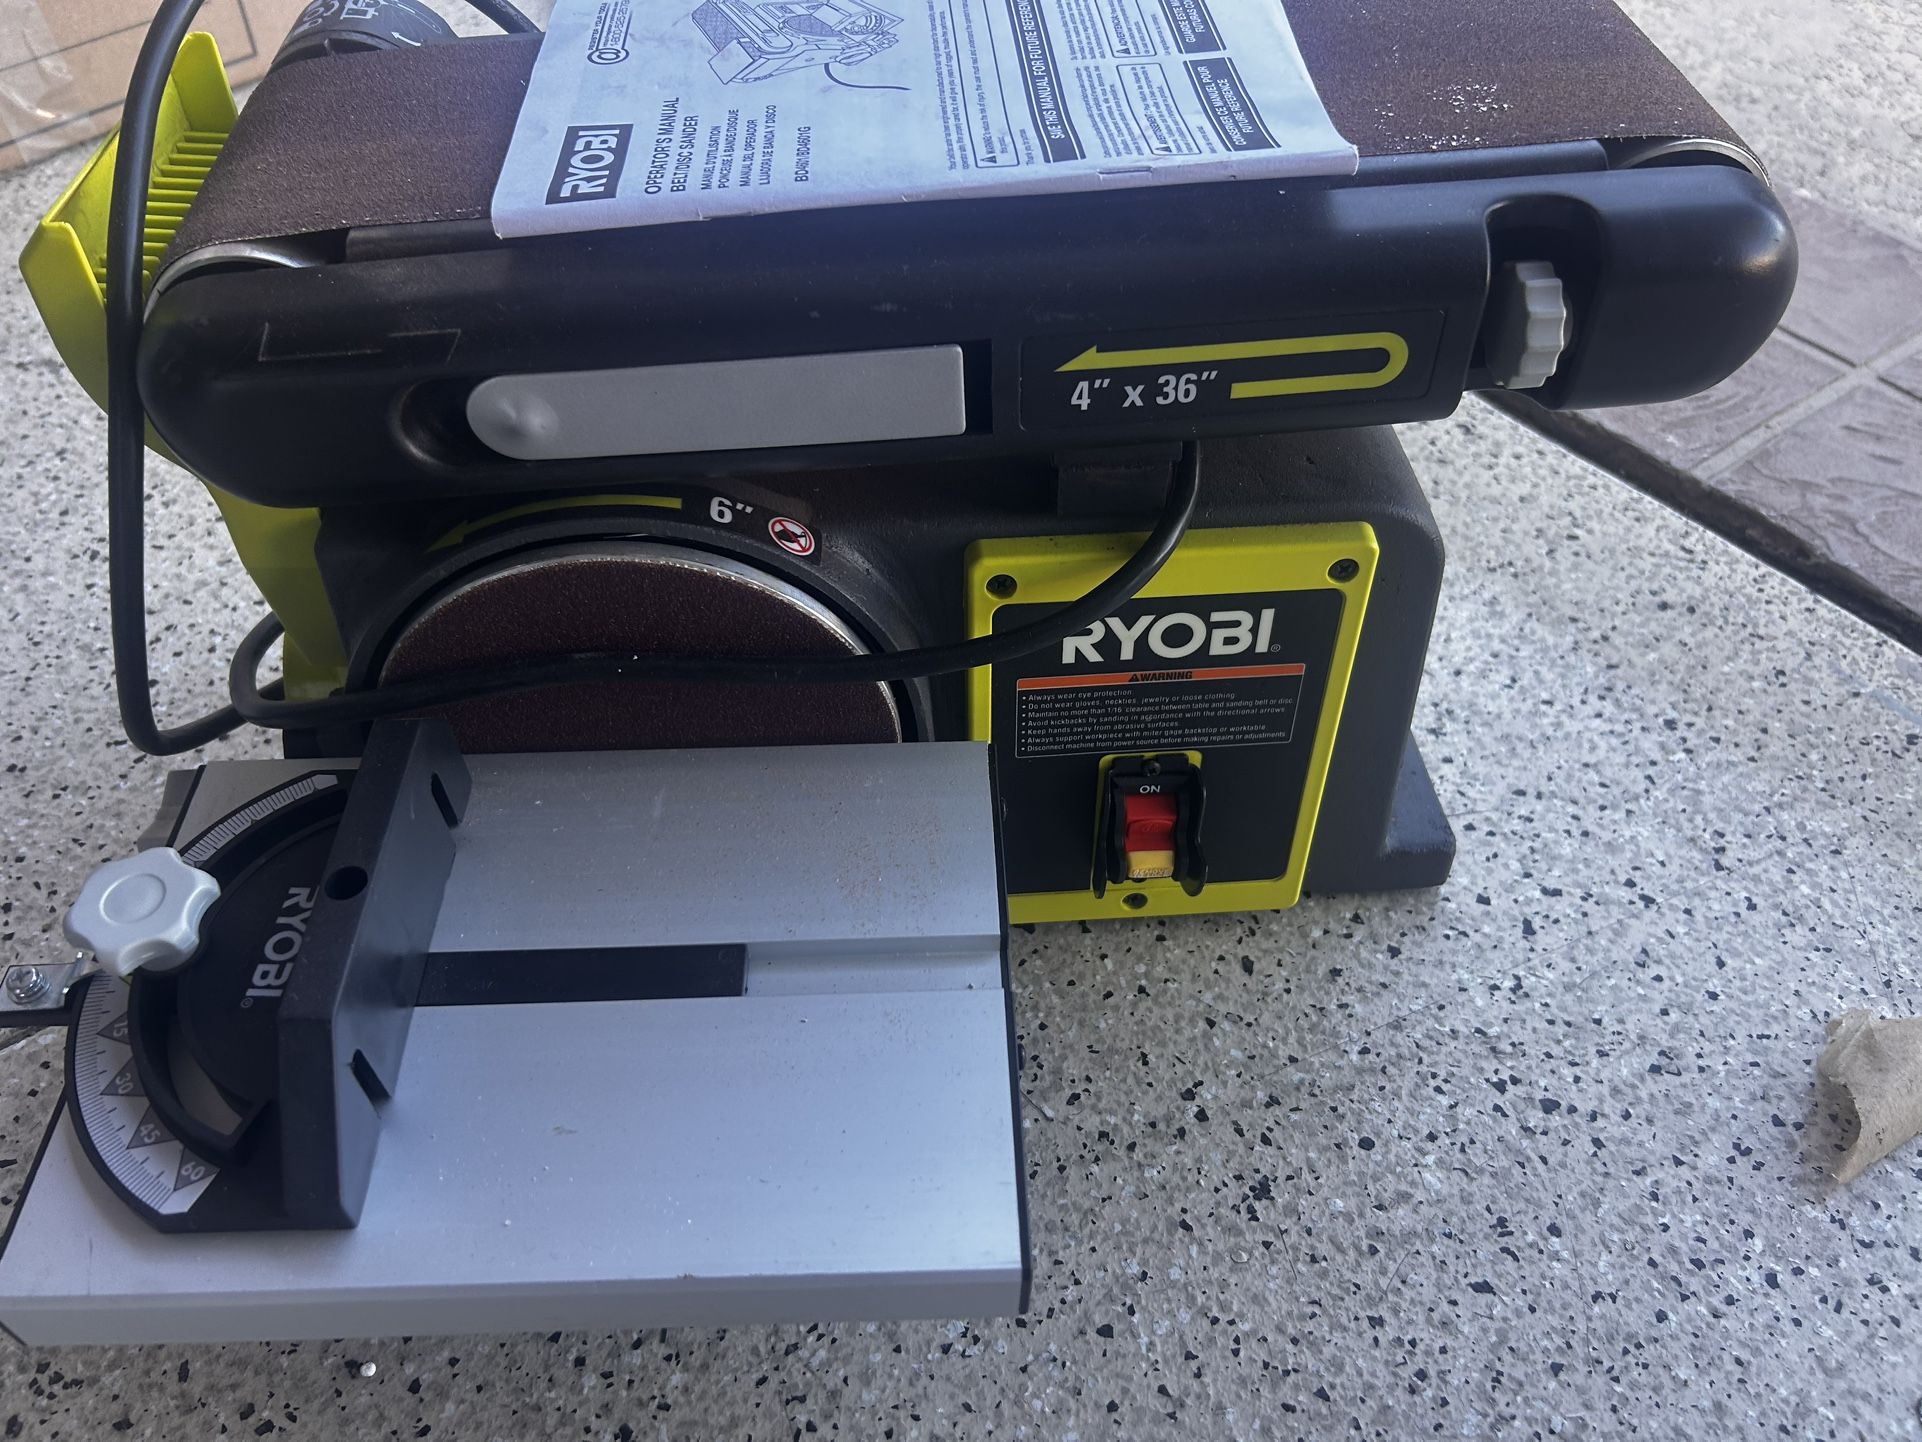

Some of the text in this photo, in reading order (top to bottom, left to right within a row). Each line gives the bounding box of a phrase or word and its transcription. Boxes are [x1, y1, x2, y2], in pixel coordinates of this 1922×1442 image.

[1173, 7, 1186, 20] ESTE
[1186, 9, 1205, 32] FUTURAS
[1179, 21, 1196, 42] GUARDE
[1025, 32, 1042, 58] FUTURE
[1031, 60, 1047, 75] FOR
[1197, 65, 1212, 82] POUR
[1036, 76, 1055, 109] MANUAL
[1206, 82, 1226, 106] MANUEL
[765, 105, 776, 123] DISCO
[1043, 111, 1060, 124] THIS
[1216, 107, 1229, 115] CE
[1048, 125, 1065, 139] SAVE
[1222, 115, 1247, 145] CONSERVER
[1233, 112, 1254, 133] FUTURE
[644, 97, 679, 195] OPERATOR'S MANUAL
[718, 159, 732, 189] PONCEUSE
[725, 109, 739, 153] BANDE/DISQUE
[763, 130, 775, 149] BANDA
[670, 115, 698, 192] BELT/DISC SANDER
[701, 125, 721, 190] MANUEL D'UTILISATION
[740, 119, 757, 186] MANUAL DEL OPERADOR
[762, 150, 773, 158] DE
[795, 126, 811, 182] BD4601/BD4601G
[560, 129, 620, 199] RYOBI
[1122, 384, 1144, 408] x
[1156, 371, 1218, 405] 36"
[1140, 670, 1193, 681] WARNING
[1141, 696, 1169, 705] jewelry
[1161, 703, 1191, 711] between
[1089, 716, 1097, 724] by
[1217, 708, 1257, 716] directional
[1027, 744, 1065, 752] Disconnect
[1183, 735, 1208, 743] making
[1210, 734, 1234, 742] repairs
[1085, 732, 1122, 740] workpiece
[1185, 727, 1217, 735] backstop
[1140, 785, 1160, 794] ON
[112, 1021, 129, 1037] 15
[116, 1072, 134, 1094] 30
[139, 1123, 161, 1144] 45
[181, 1161, 206, 1182] 60
